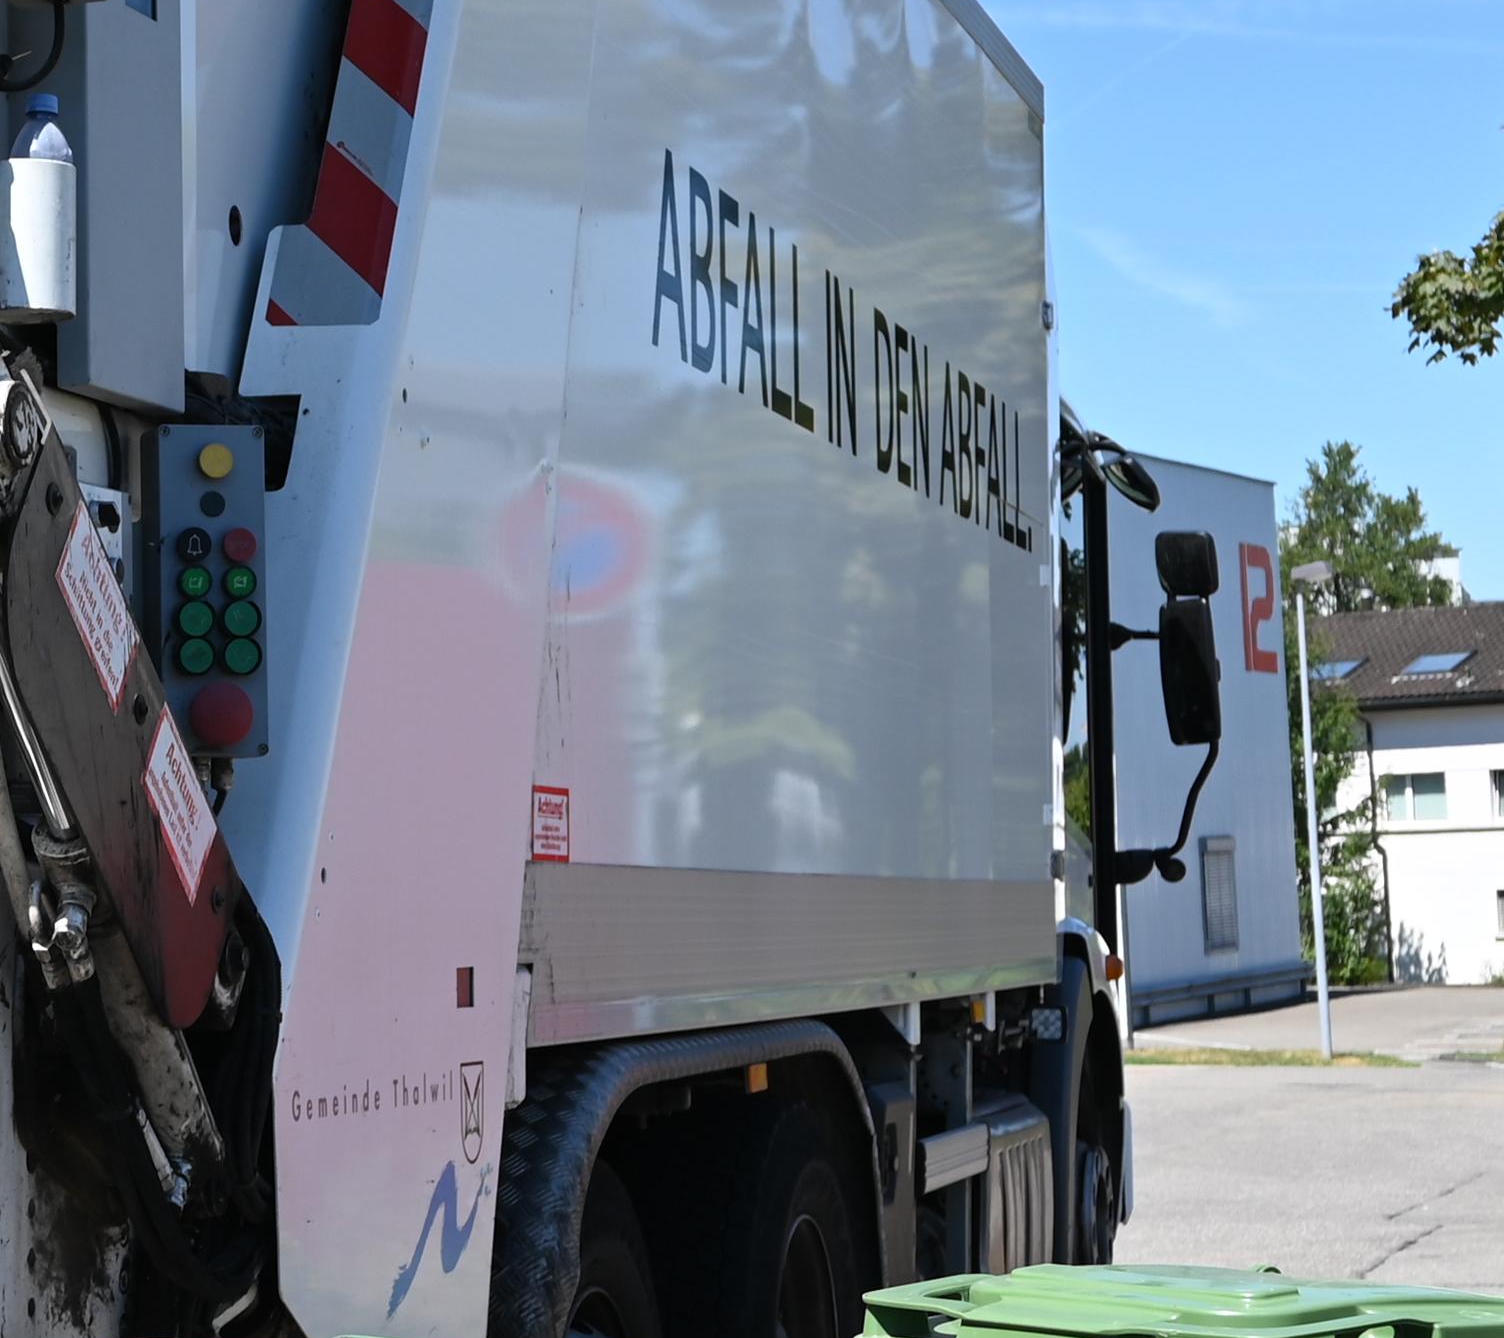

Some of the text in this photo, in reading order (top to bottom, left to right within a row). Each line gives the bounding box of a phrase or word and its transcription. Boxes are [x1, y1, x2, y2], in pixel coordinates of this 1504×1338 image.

[651, 147, 1033, 553] ABFALL IN DEN ABFALL.
[291, 1068, 454, 1122] Gemeinde Thalwil
